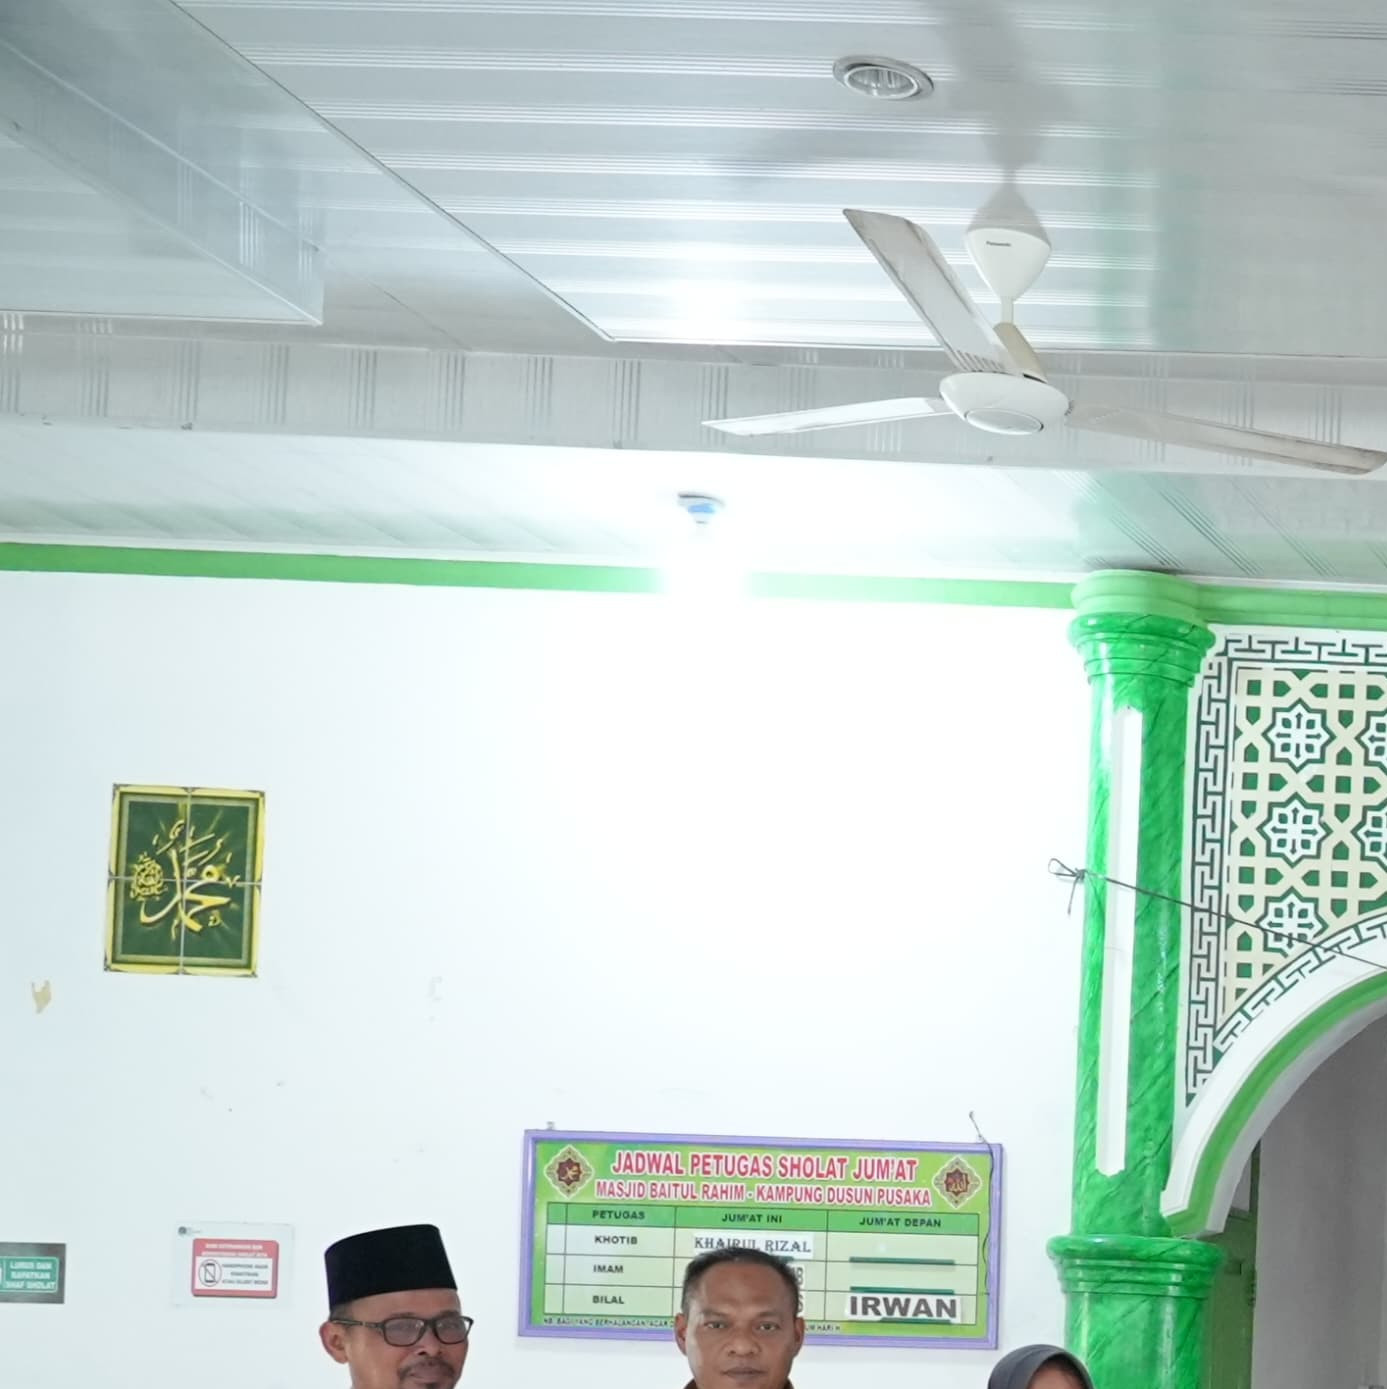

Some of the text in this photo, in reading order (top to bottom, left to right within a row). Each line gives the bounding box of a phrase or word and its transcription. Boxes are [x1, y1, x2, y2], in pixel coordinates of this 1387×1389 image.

[612, 1152, 917, 1181] JADWAL PETUGAS SHOLAT JUM'AT
[596, 1181, 646, 1198] MASJID
[649, 1182, 697, 1199] BAITUL
[702, 1184, 744, 1200] RAHIM
[756, 1186, 823, 1203] KAMPUNG
[827, 1187, 873, 1204] DUSUN
[877, 1188, 931, 1205] PUSAKA
[592, 1210, 645, 1220] PETUGAS
[766, 1215, 782, 1223] INI
[904, 1218, 941, 1228] DEPAN
[594, 1235, 638, 1245] KHOTIB
[765, 1240, 811, 1253] RIZAL
[593, 1264, 624, 1273] IMAM
[592, 1295, 624, 1305] BILAL
[849, 1295, 957, 1319] IRWAN
